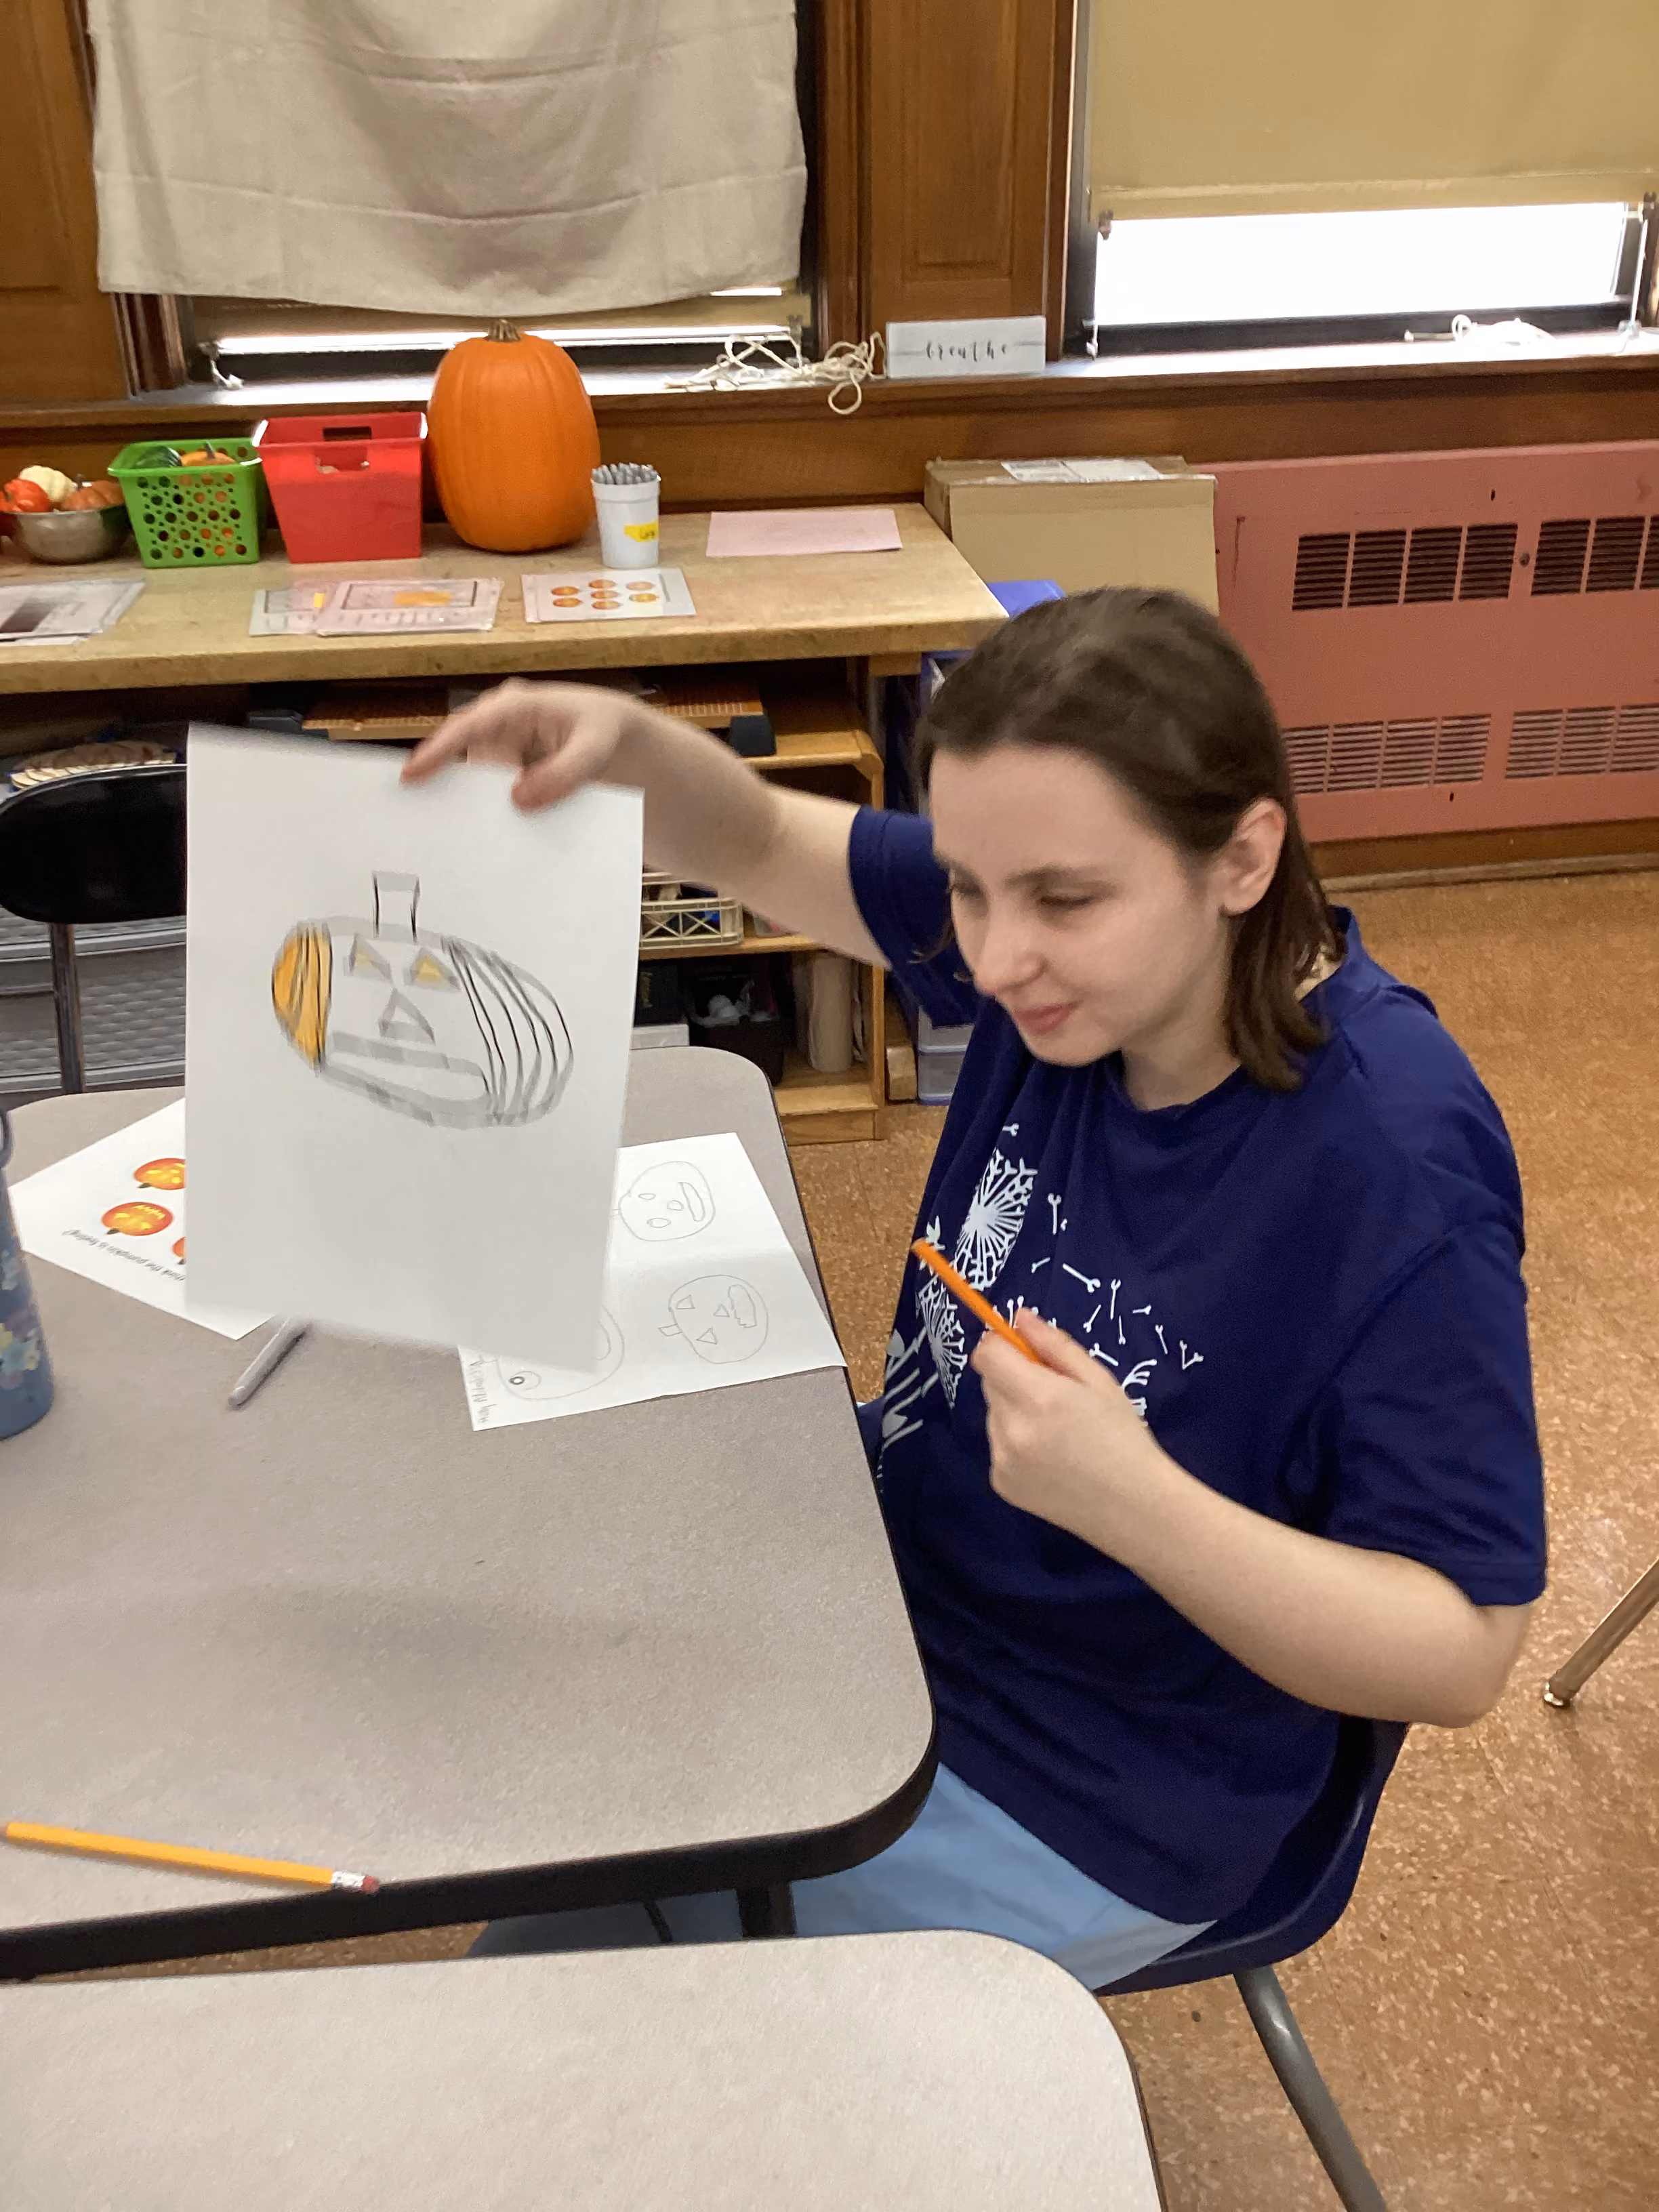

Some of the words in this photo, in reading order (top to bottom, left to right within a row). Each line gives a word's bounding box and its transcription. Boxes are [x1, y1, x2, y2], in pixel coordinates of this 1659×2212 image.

[97, 1242, 109, 1250] is
[106, 1246, 150, 1265] pumpkin
[144, 1262, 163, 1272] the
[160, 1268, 186, 1282] think
